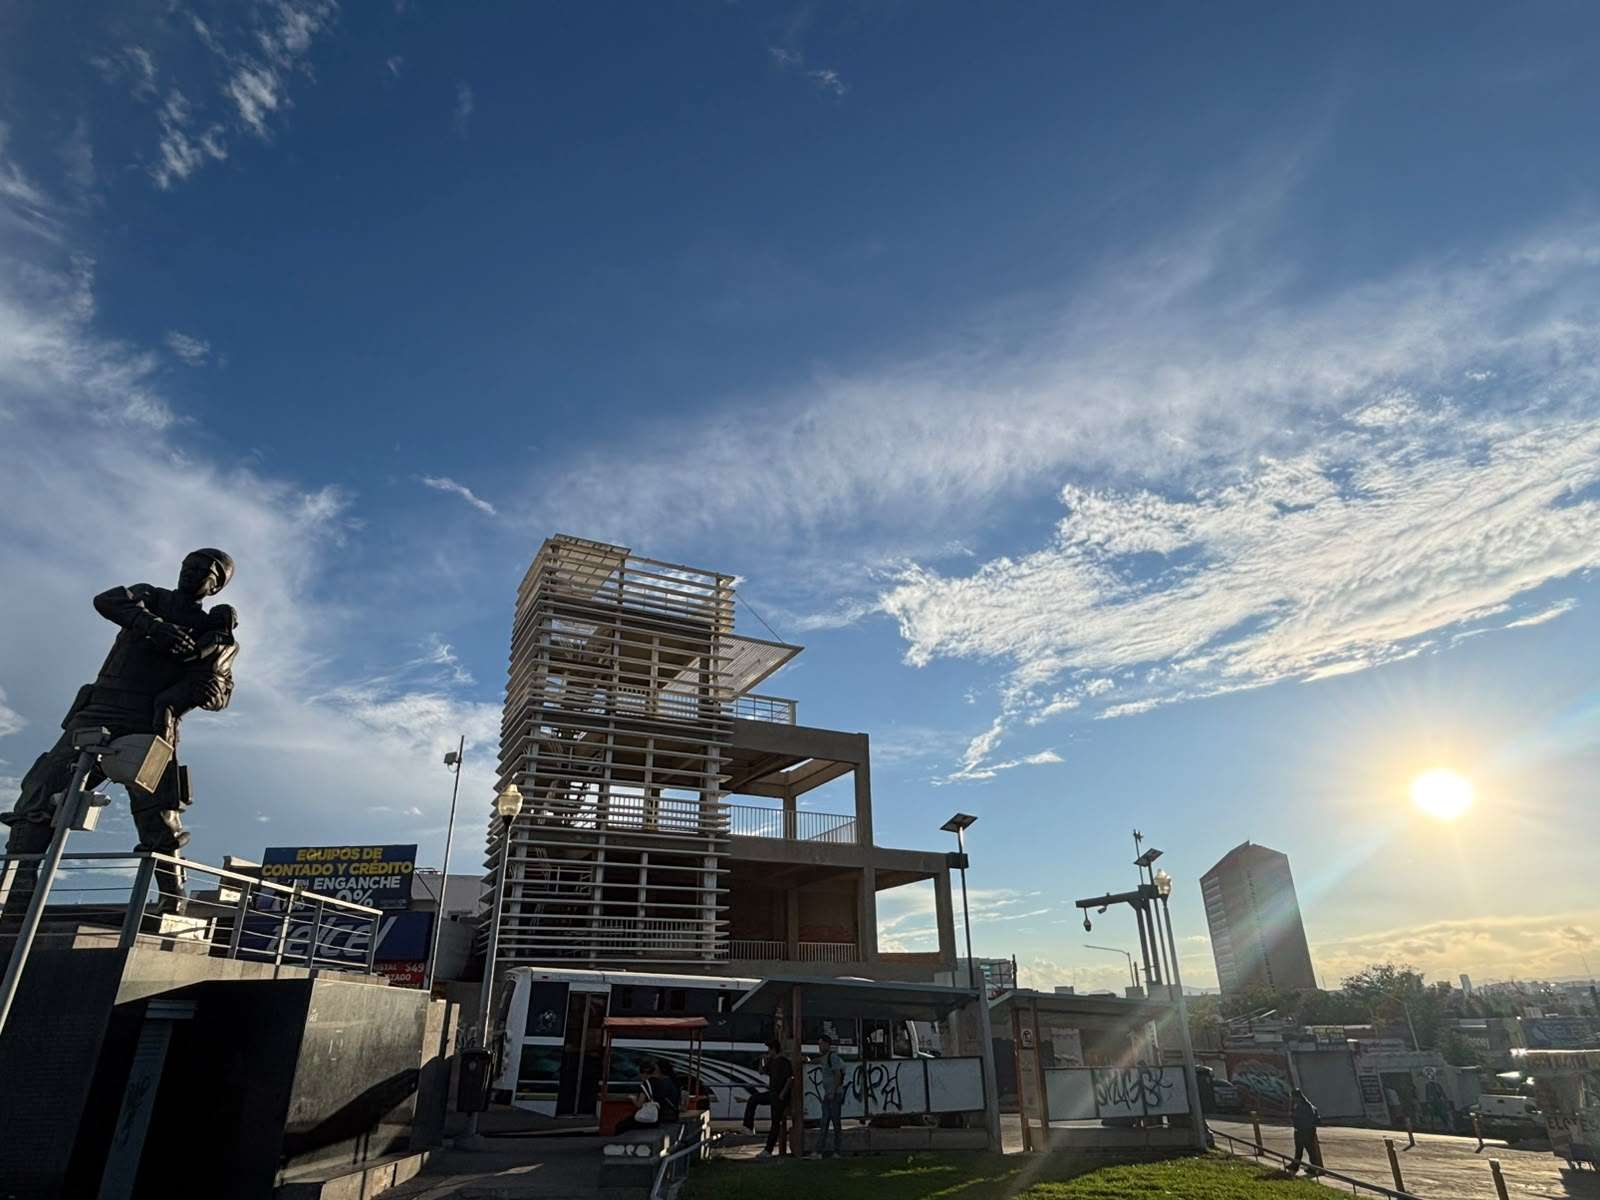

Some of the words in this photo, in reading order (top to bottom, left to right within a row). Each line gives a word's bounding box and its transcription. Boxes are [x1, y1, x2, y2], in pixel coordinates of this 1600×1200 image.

[296, 848, 361, 861] EQUIPOS
[362, 847, 384, 860] DE
[261, 863, 334, 877] CONTADO
[336, 863, 348, 876] Y
[349, 860, 414, 875] CRÉDITO
[313, 876, 402, 890] ENGANCHE
